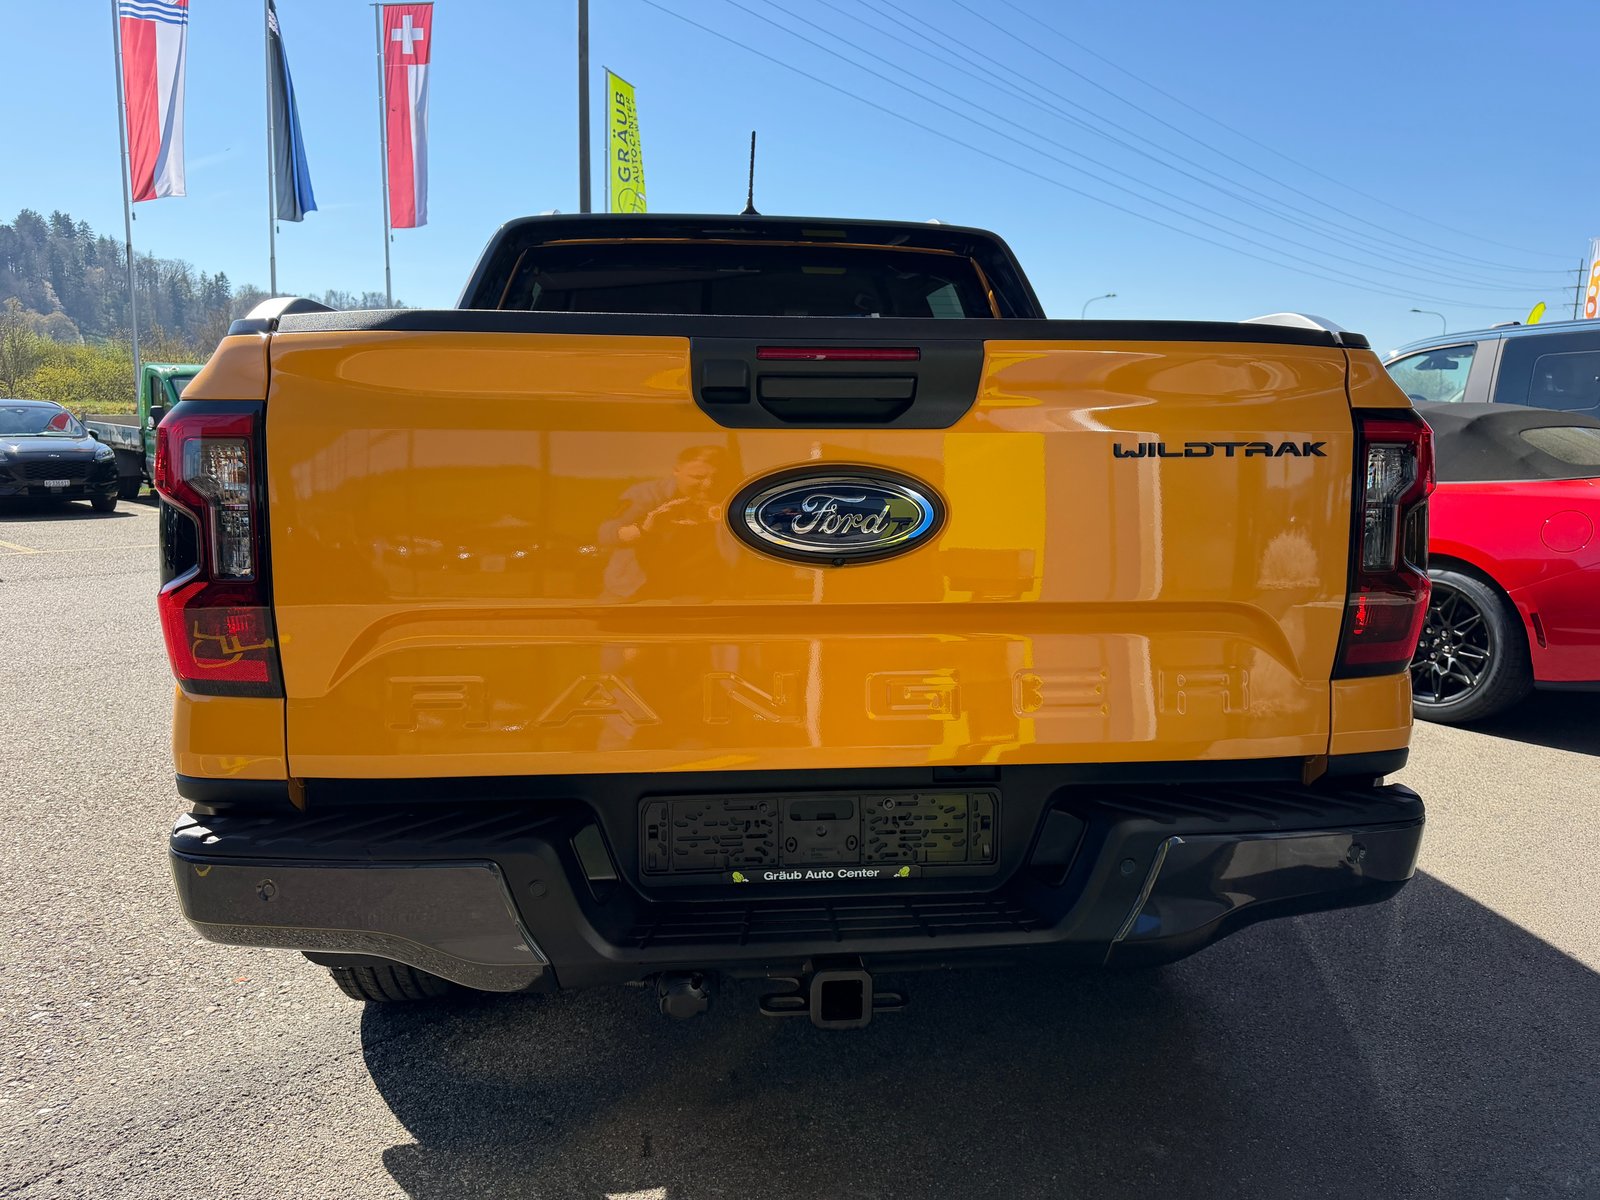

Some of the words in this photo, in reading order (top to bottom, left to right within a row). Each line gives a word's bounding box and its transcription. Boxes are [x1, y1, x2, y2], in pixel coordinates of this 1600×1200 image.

[613, 91, 631, 182] GRÄUB
[626, 97, 639, 183] AUTOCENTER
[1113, 442, 1328, 458] WILDTRAK
[791, 493, 891, 534] Ford
[387, 665, 1251, 731] RANGER
[763, 871, 802, 881] Gräub
[805, 870, 834, 880] Auto
[837, 869, 880, 879] Center
